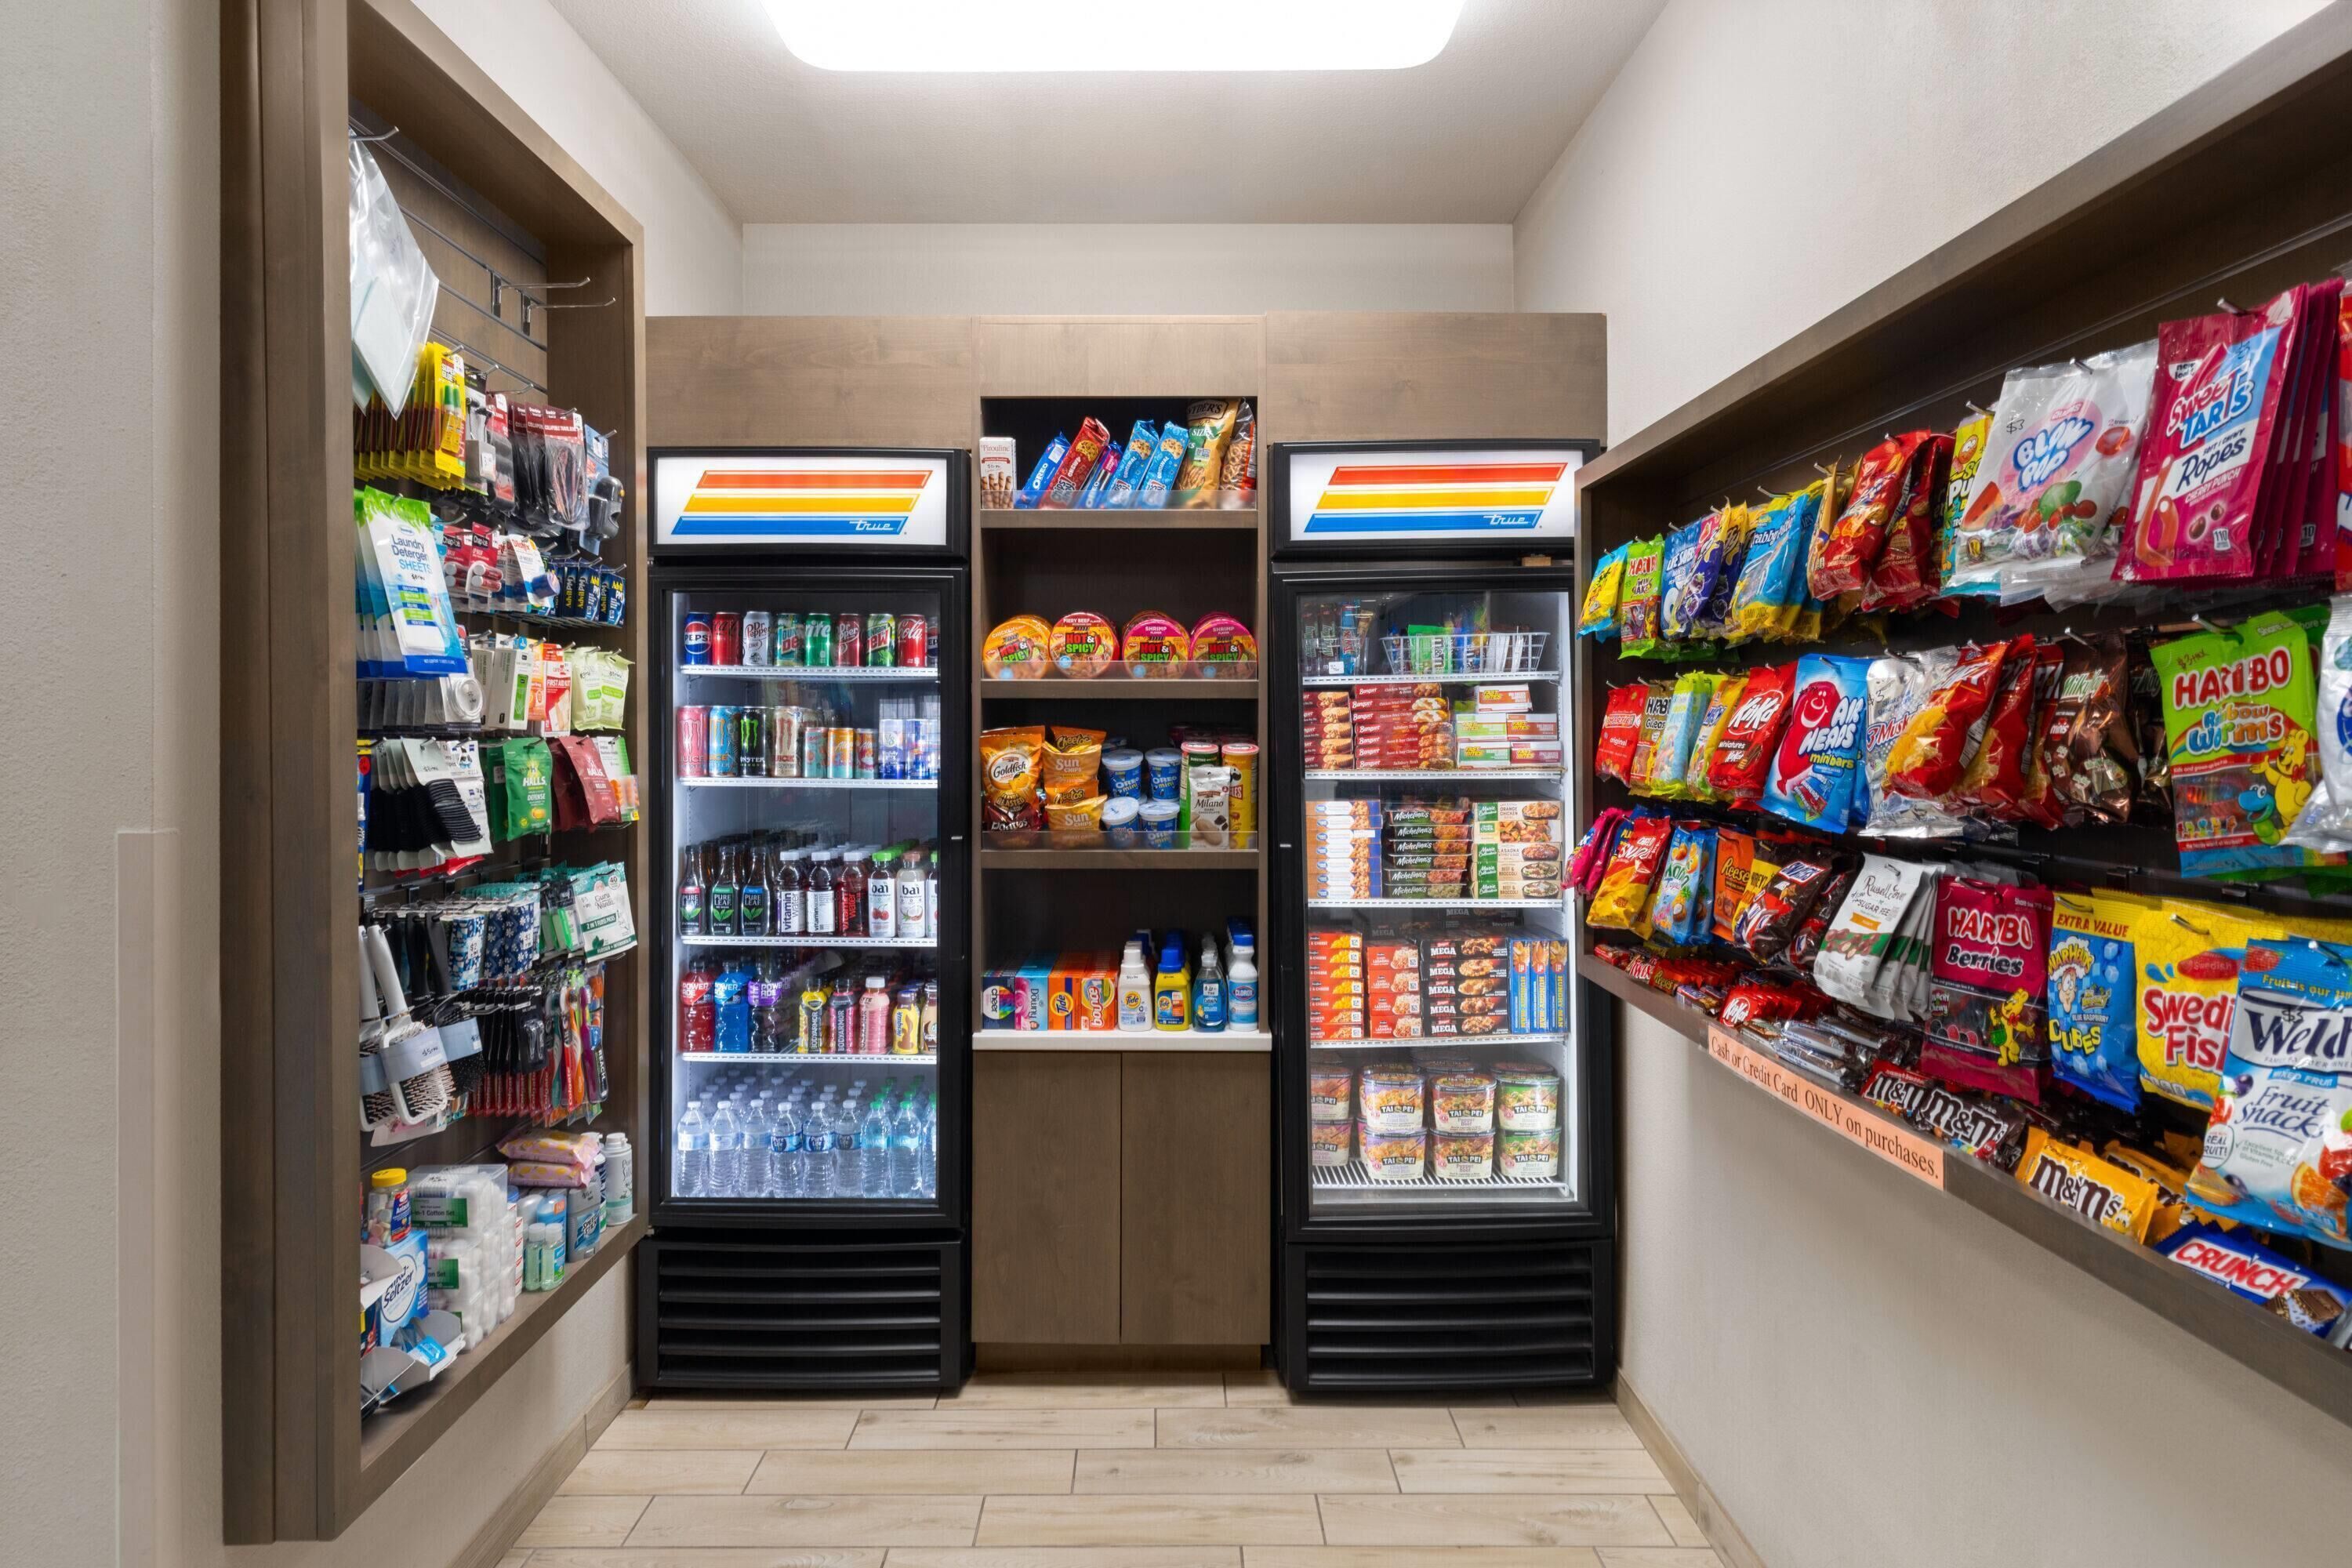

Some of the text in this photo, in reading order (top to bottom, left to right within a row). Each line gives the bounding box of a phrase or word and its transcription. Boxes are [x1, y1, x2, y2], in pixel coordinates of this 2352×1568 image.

[2014, 418, 2095, 470] BLOW
[2019, 450, 2069, 492] POP
[2176, 437, 2246, 492] Ropes
[1033, 463, 1048, 489] OREO
[392, 534, 426, 552] Laundry
[399, 559, 432, 574] SHEETS
[1066, 633, 1087, 644] HOT
[1066, 644, 1094, 653] SPICY
[1141, 644, 1161, 653] HOT
[1209, 644, 1229, 653] HOT
[2174, 647, 2292, 710] HARIBO
[1831, 697, 1864, 728] AIR
[1798, 723, 1857, 754] HEADS
[2050, 724, 2069, 735] minis
[1057, 734, 1091, 750] Cheetos
[1610, 737, 1628, 746] original
[993, 762, 1027, 778] Goldfish
[1056, 758, 1080, 770] Sun
[1195, 799, 1224, 808] Milano
[1065, 814, 1088, 826] Sun
[871, 883, 889, 894] bai
[902, 884, 920, 895] bai
[1864, 876, 1892, 898] Russell
[1948, 906, 2033, 949] HARIBO
[2056, 913, 2129, 938] EXTRA VALUE
[1946, 944, 2024, 976] Berries
[2049, 943, 2093, 975] WARHEADS
[2194, 961, 2232, 971] Swedish
[2312, 985, 2331, 996] our
[1029, 989, 1039, 1018] Downy
[1056, 995, 1069, 1013] Tide
[1125, 996, 1139, 1004] Tide
[2083, 1014, 2109, 1023] RASPBERRY
[2144, 989, 2237, 1033] Swedi
[2049, 1019, 2101, 1054] CUBES
[597, 1048, 606, 1080] REACH
[1711, 1036, 1939, 1179] Cash or Credit Card ONLY on purchases.
[2256, 1086, 2329, 1115] Fruit
[2205, 1135, 2227, 1149] REAL
[2176, 1241, 2301, 1294] CRUNCH
